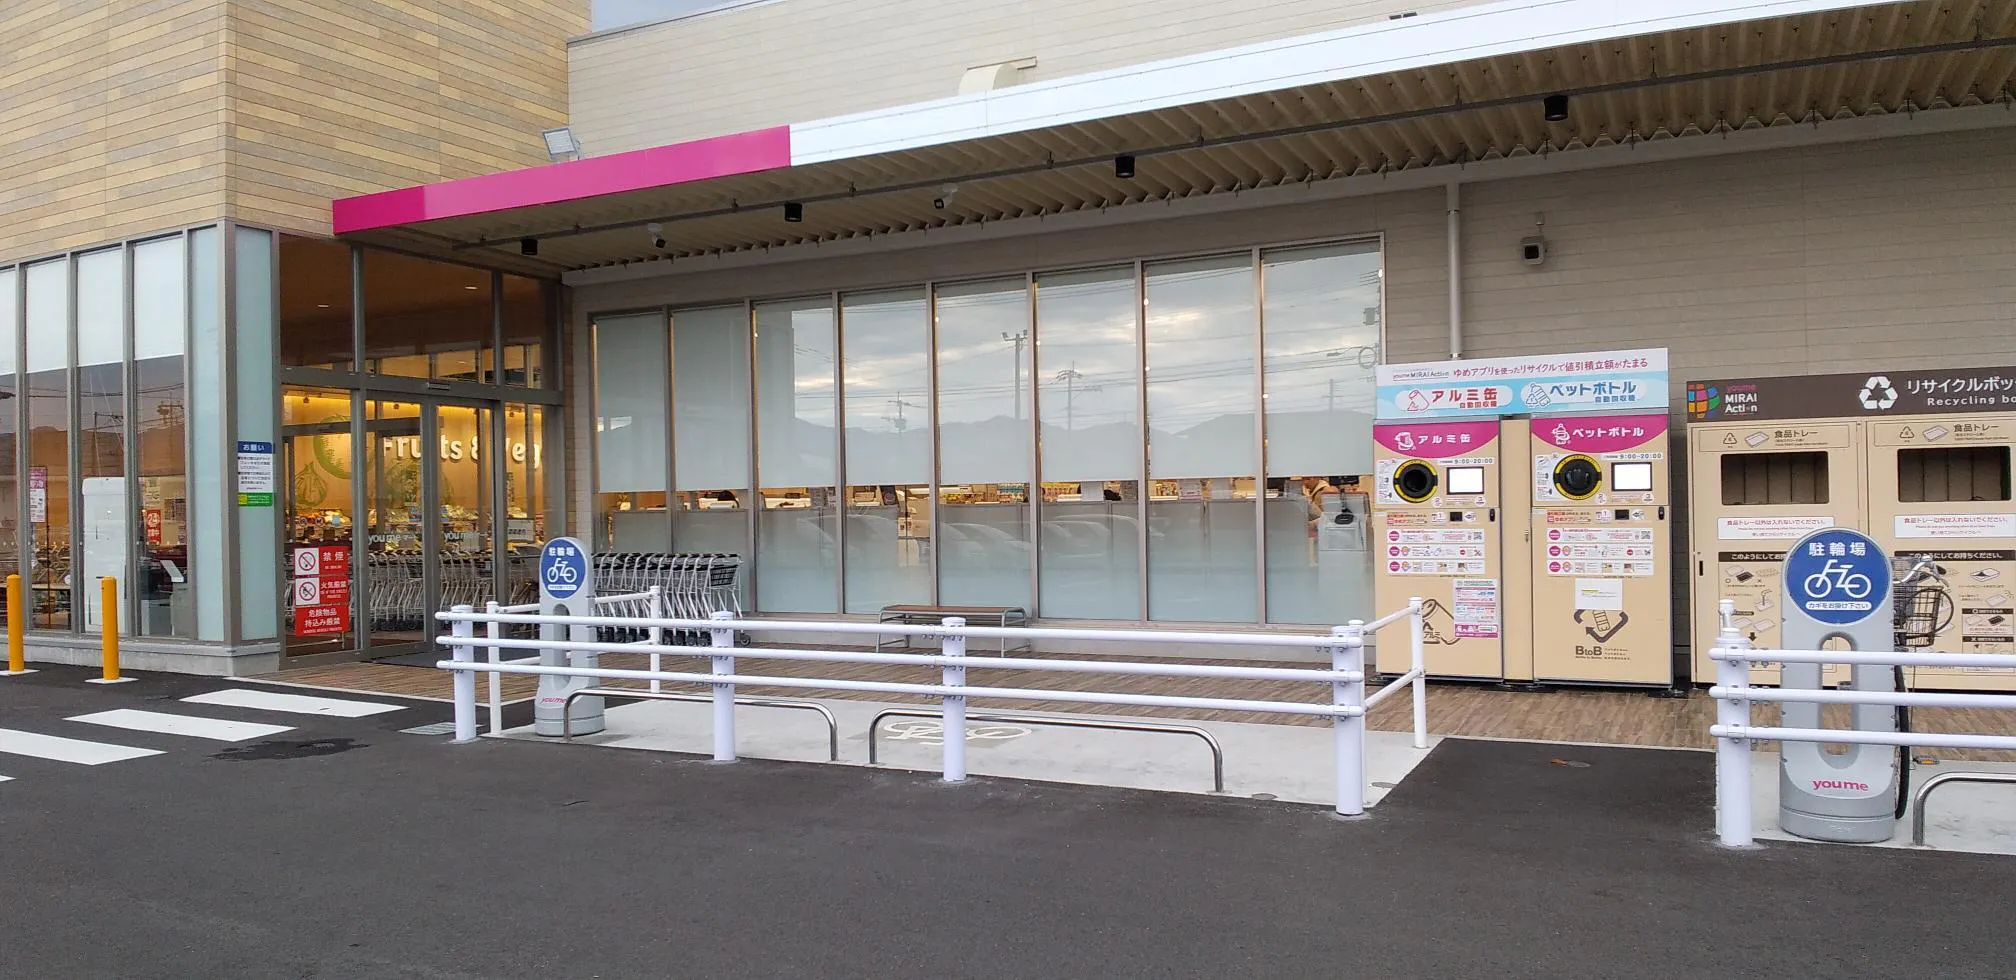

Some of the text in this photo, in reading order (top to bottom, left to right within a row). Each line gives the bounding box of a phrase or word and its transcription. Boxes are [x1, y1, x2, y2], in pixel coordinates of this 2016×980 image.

[1453, 357, 1648, 379] ゆめアプリを使ったリサイクルで値引積立額がたまる
[1550, 381, 1636, 397] ペットボトル
[1907, 376, 2016, 394] リサイクルボッ
[1432, 388, 1498, 402] アルミ缶
[1725, 393, 1757, 403] MIRAI
[1928, 395, 1995, 406] Recycling
[1573, 426, 1644, 438] ペットボトル
[1955, 423, 1999, 432] 食品トレー
[1418, 433, 1470, 444] アルミ缶
[1775, 429, 1818, 438] 食品トレー
[383, 434, 463, 461] Fruts
[1808, 542, 1867, 556] 駐輪場
[322, 552, 344, 561] 禁煙
[308, 608, 337, 617] 危険物品
[1576, 645, 1602, 656] BtoB
